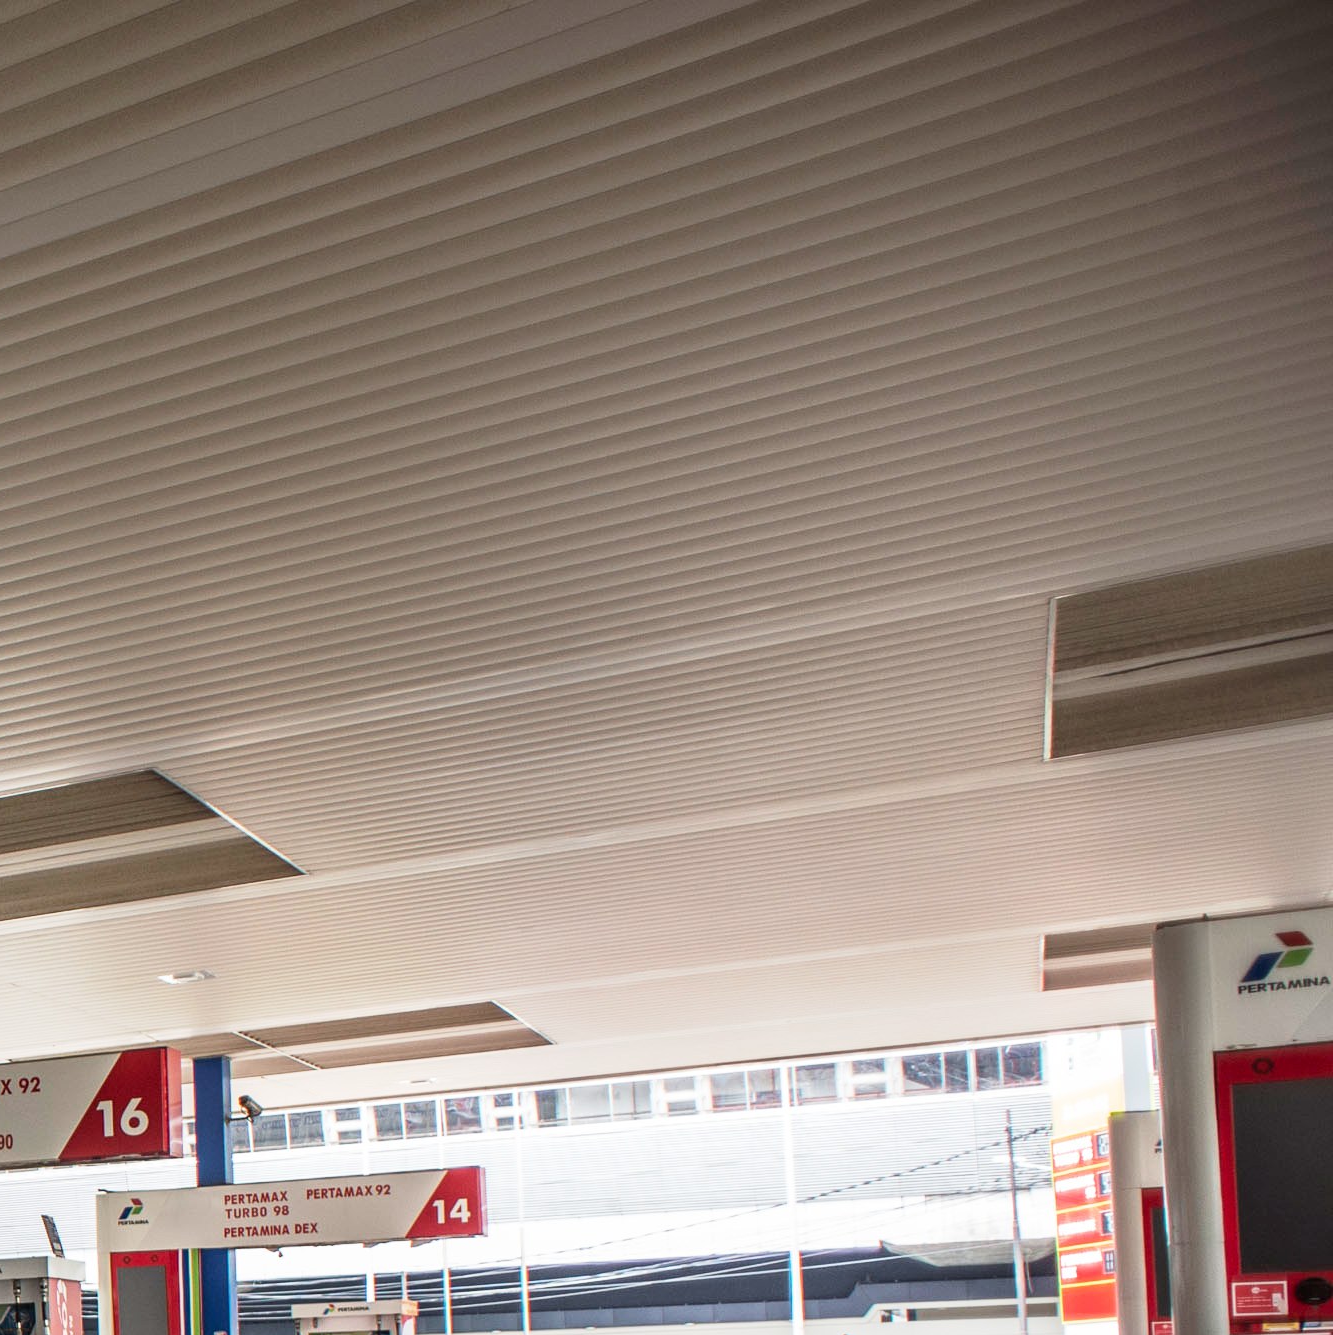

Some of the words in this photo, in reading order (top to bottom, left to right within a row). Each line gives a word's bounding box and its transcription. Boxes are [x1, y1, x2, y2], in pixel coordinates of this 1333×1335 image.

[1237, 976, 1330, 995] PERTAMINA
[18, 1077, 41, 1096] 92
[96, 1097, 150, 1137] 16
[224, 1190, 288, 1205] PERTAMAX
[306, 1185, 373, 1200] PERTAMAX
[375, 1184, 391, 1196] 92
[225, 1206, 267, 1218] TURBO
[273, 1204, 290, 1216] 98
[431, 1198, 471, 1224] 14
[117, 1218, 149, 1226] PERTAMINA
[224, 1224, 290, 1238] PERTAMINA
[294, 1222, 318, 1235] DEX
